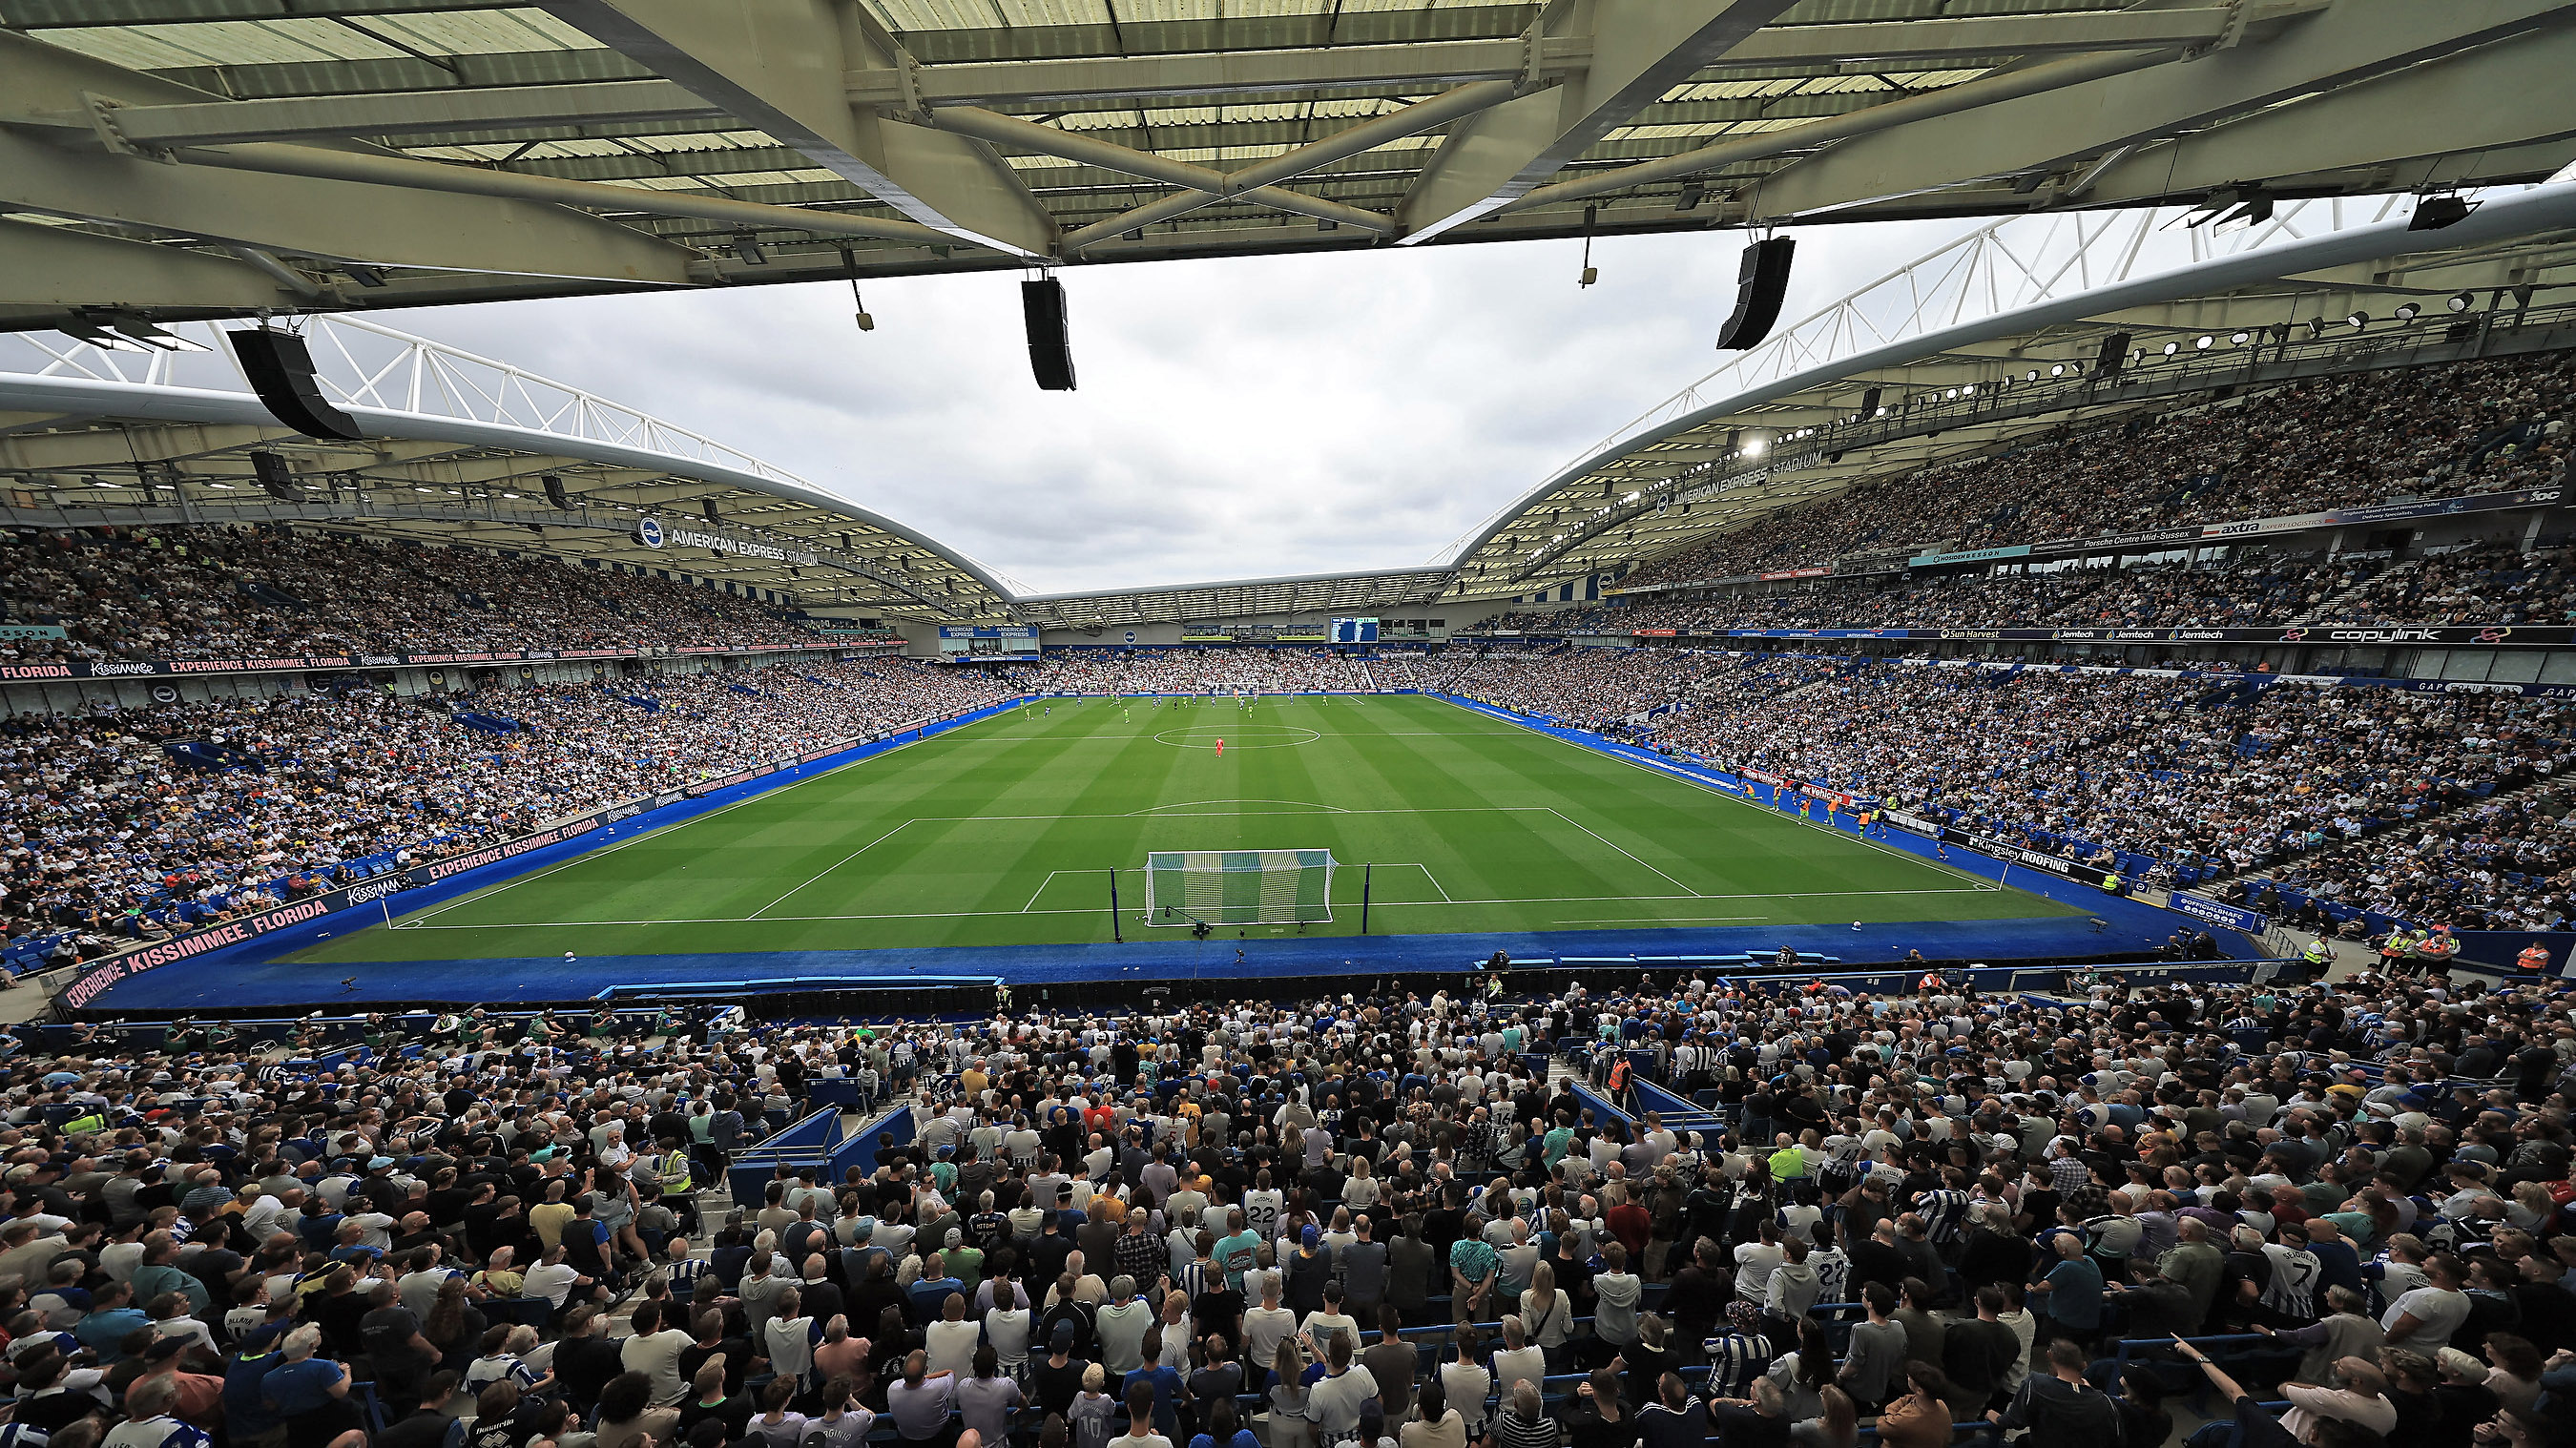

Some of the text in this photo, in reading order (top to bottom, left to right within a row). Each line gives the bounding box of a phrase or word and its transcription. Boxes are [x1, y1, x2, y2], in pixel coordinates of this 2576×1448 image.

[2526, 424, 2541, 436] H
[1673, 450, 1822, 506] AMERICAN EXPRESS STADIUM
[2221, 523, 2259, 534] axtra
[2084, 530, 2190, 548] Porsche Centre Mid-Sussex
[672, 529, 737, 552] AMERICAN
[738, 542, 785, 561] EXPRESS
[786, 550, 819, 566] STADIUM
[2034, 543, 2075, 551] PORSCHE
[2116, 631, 2153, 639] Jemtech
[2179, 631, 2223, 639] Jemtech
[2330, 628, 2441, 642] copylink
[170, 657, 350, 672] EXPERIENCE KISSIMMEE, FLORIDA
[361, 654, 400, 666] Kissimmee
[408, 653, 453, 663] EXPERIENCE
[454, 653, 494, 662] KISSIMMEE,
[3, 665, 73, 679] FLORIDA
[91, 662, 156, 677] Kissimmee
[2546, 688, 2576, 697] GAP
[724, 770, 755, 787] KISSIMMEE,
[756, 764, 776, 778] FLORIDA
[1758, 773, 1784, 786] Vehicles
[607, 804, 642, 823] Kissimmee
[429, 817, 599, 880] EXPERIENCE KISSIMMEE, FLORIDA
[1978, 839, 2069, 873] Kingsley ROOFING
[347, 878, 401, 906] Kissimm
[2180, 898, 2244, 921] @OFFICIALBHAFC
[66, 900, 328, 1009] EXPERIENCE KISSIMMEE, FLORIDA
[1229, 1026, 1236, 1037] 5
[1496, 1112, 1511, 1125] 16
[1249, 1206, 1276, 1224] 22
[1821, 1251, 1839, 1262] MITOMA
[2283, 1251, 2317, 1265] SEIGULLS
[1818, 1259, 1845, 1287] 22
[2292, 1262, 2313, 1286] 7
[1080, 1416, 1102, 1438] 10
